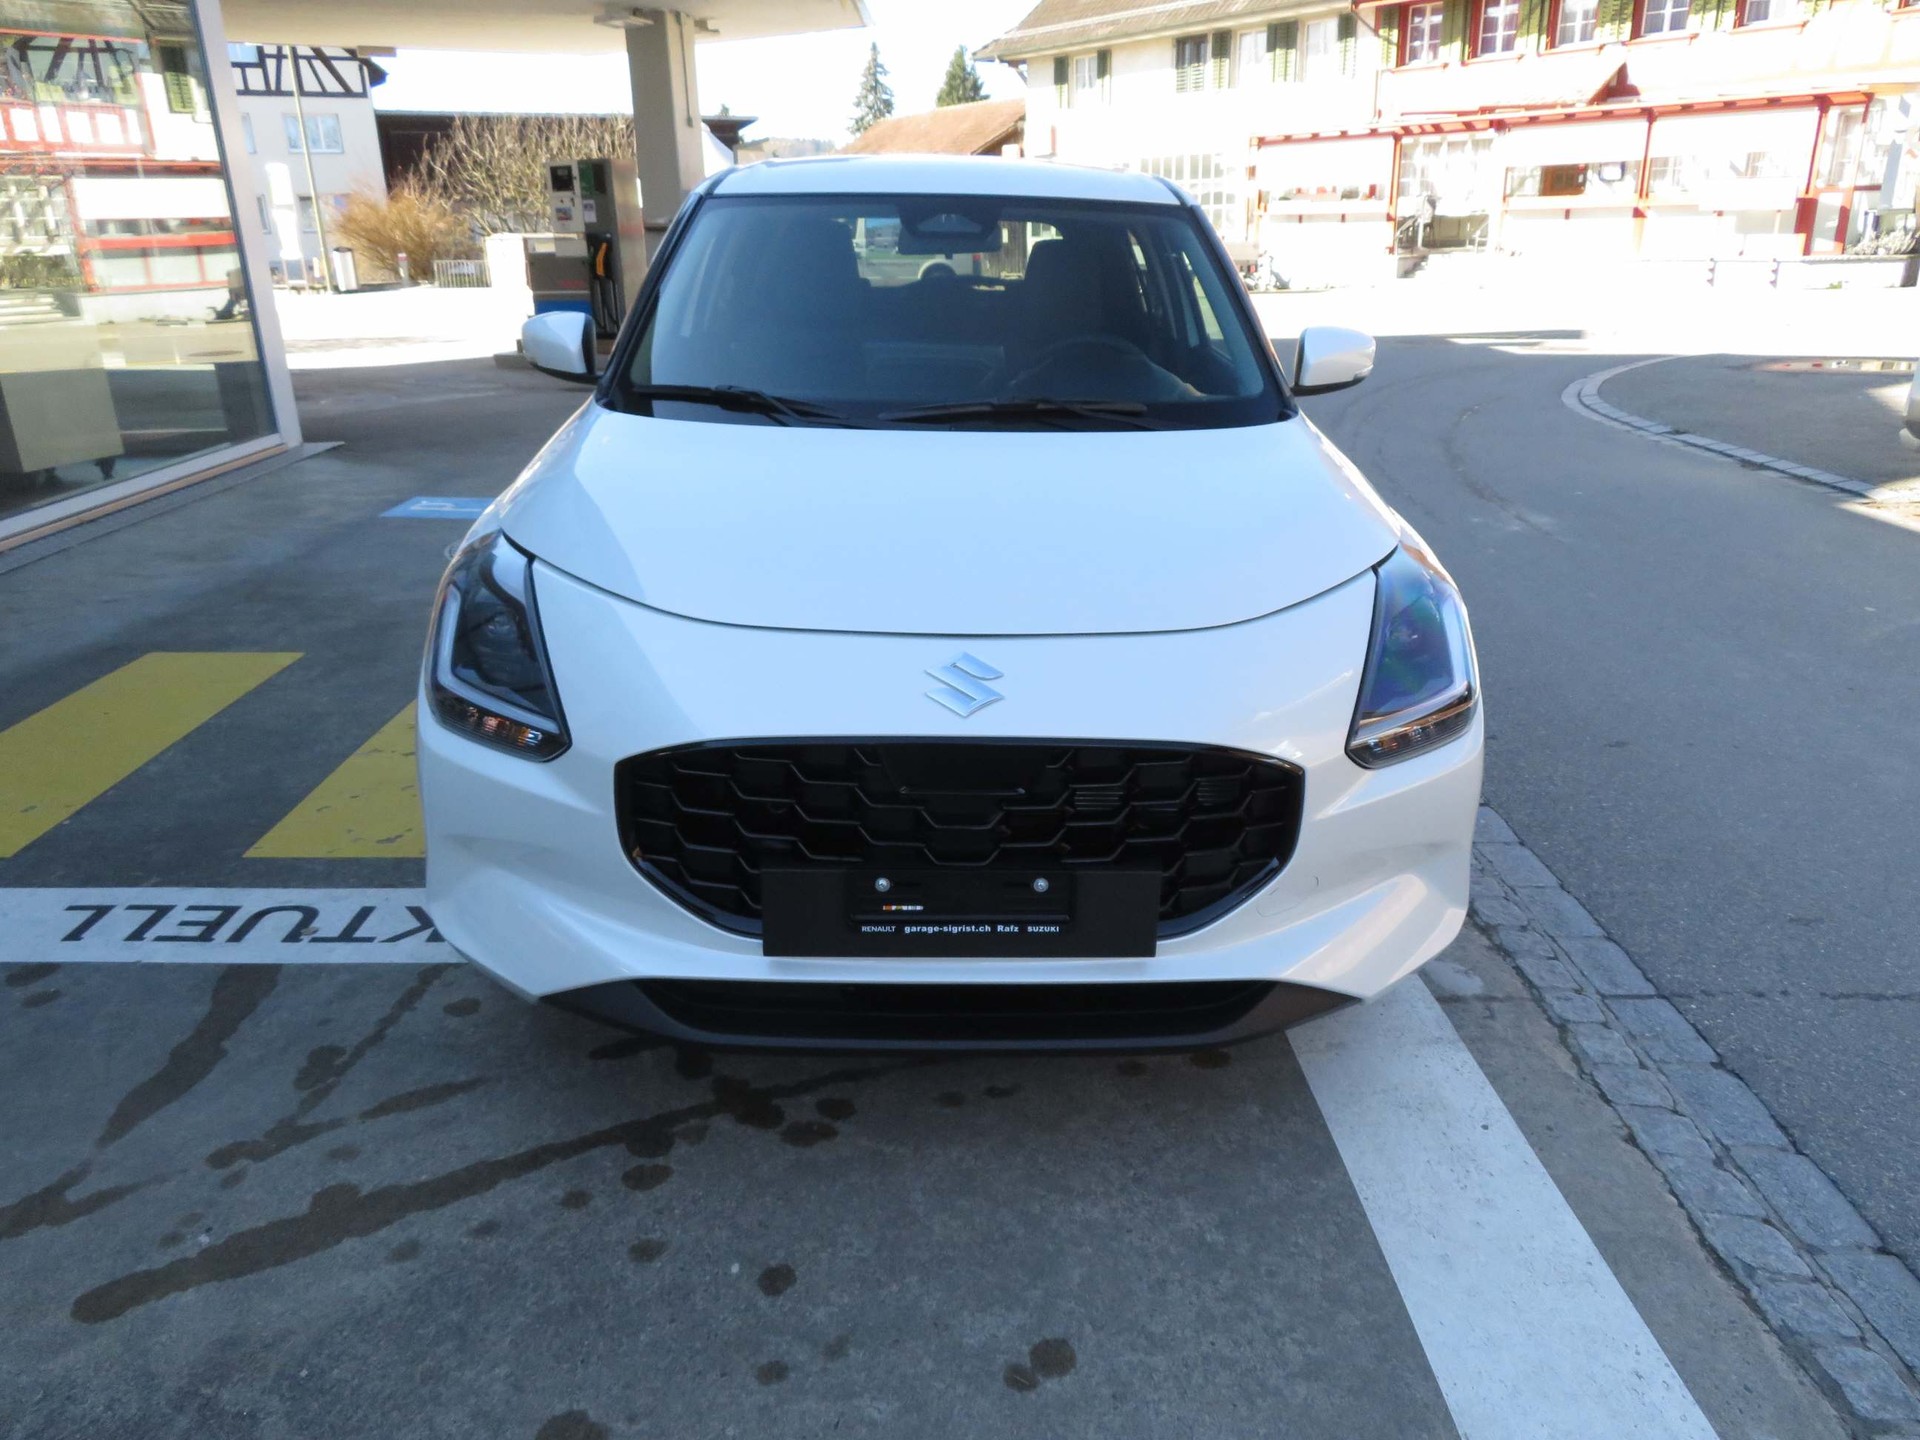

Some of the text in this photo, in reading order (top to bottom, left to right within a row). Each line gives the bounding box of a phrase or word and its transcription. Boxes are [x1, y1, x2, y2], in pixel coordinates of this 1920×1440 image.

[861, 925, 1060, 934] RENAULT garage-sigrist.ch Rafz SUZUKI
